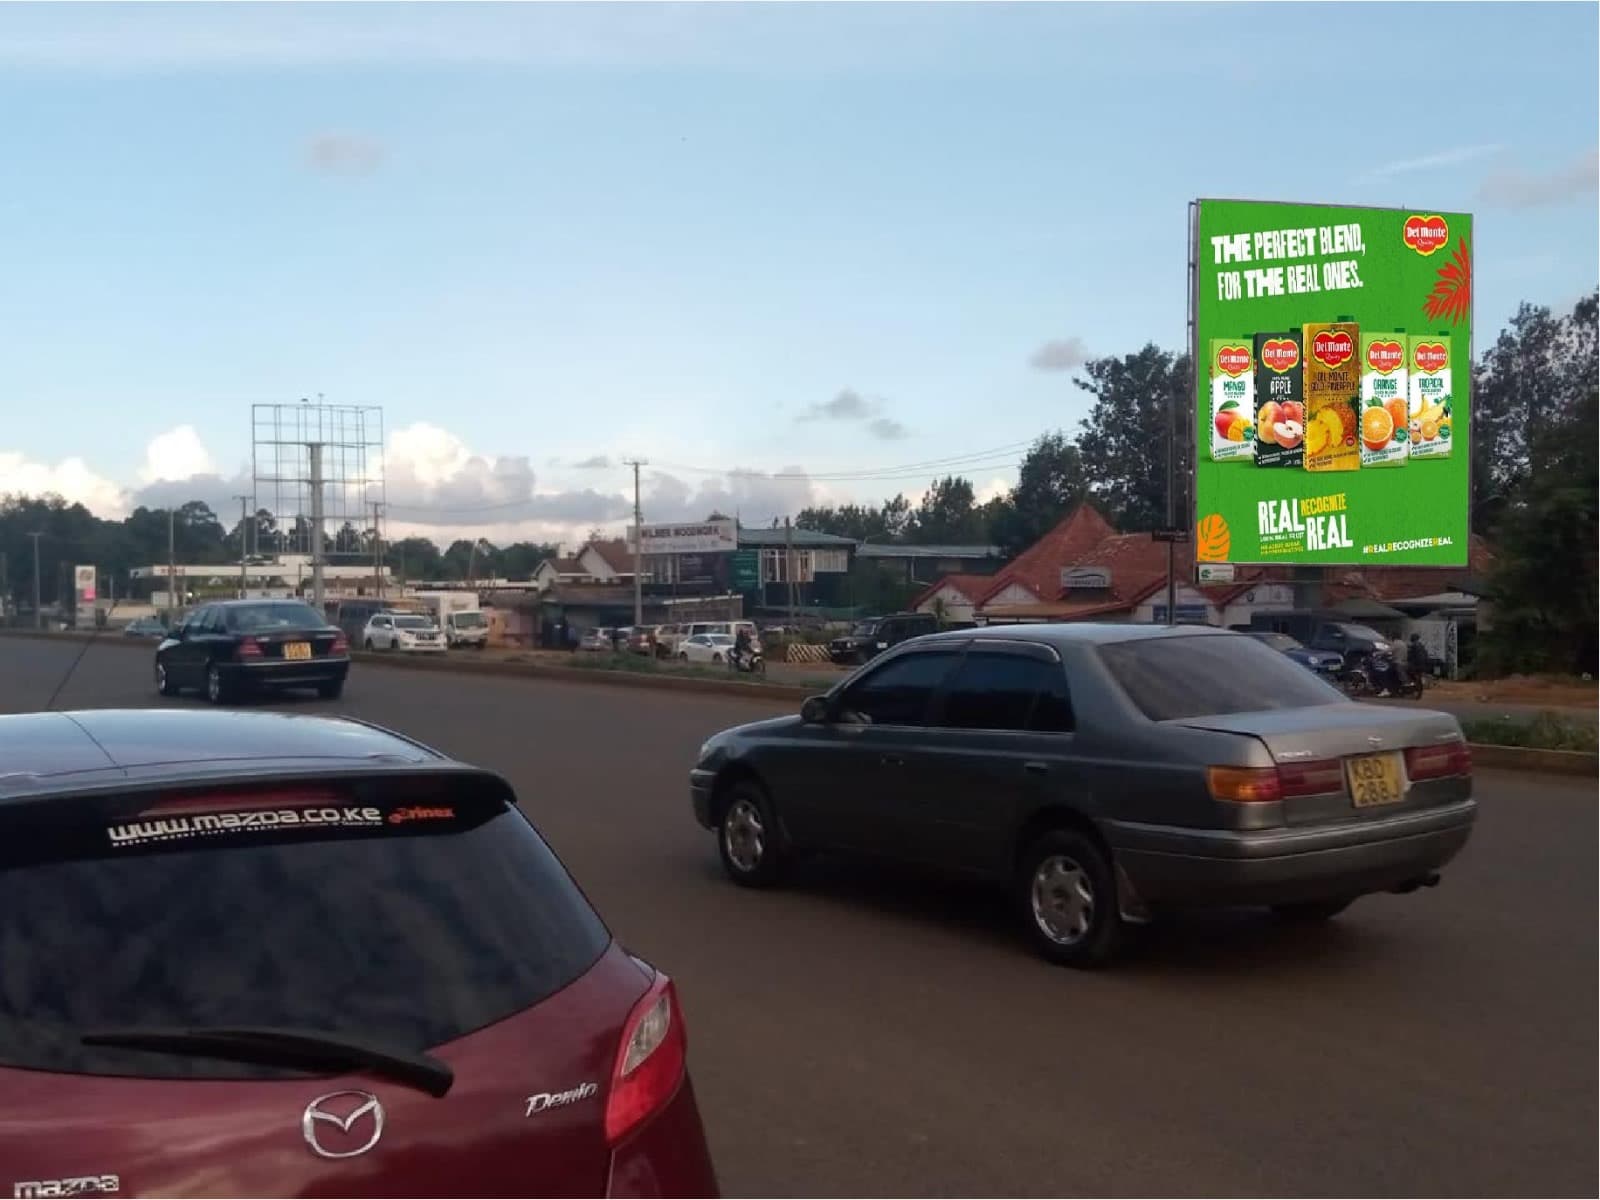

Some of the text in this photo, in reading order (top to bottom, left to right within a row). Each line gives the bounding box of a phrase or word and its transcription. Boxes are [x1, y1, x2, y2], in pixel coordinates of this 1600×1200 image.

[1407, 227, 1446, 238] Del Monte
[1211, 223, 1366, 265] THE PERFECT BLEND,
[1217, 260, 1364, 301] FOR THE REAL ONES.
[1265, 348, 1297, 358] Del Monte
[1315, 341, 1351, 352] Del Monte
[1223, 380, 1246, 392] MANGO
[1270, 380, 1291, 394] APPLE
[1373, 378, 1397, 390] ORANGE
[1418, 378, 1444, 388] TROPICAL
[1300, 492, 1347, 517] RECOGNIZE
[1257, 498, 1306, 535] REAL
[1306, 514, 1353, 551] REAL
[1363, 536, 1453, 554] #REALRECOGNIZEREAL
[525, 1082, 598, 1118] Demio
